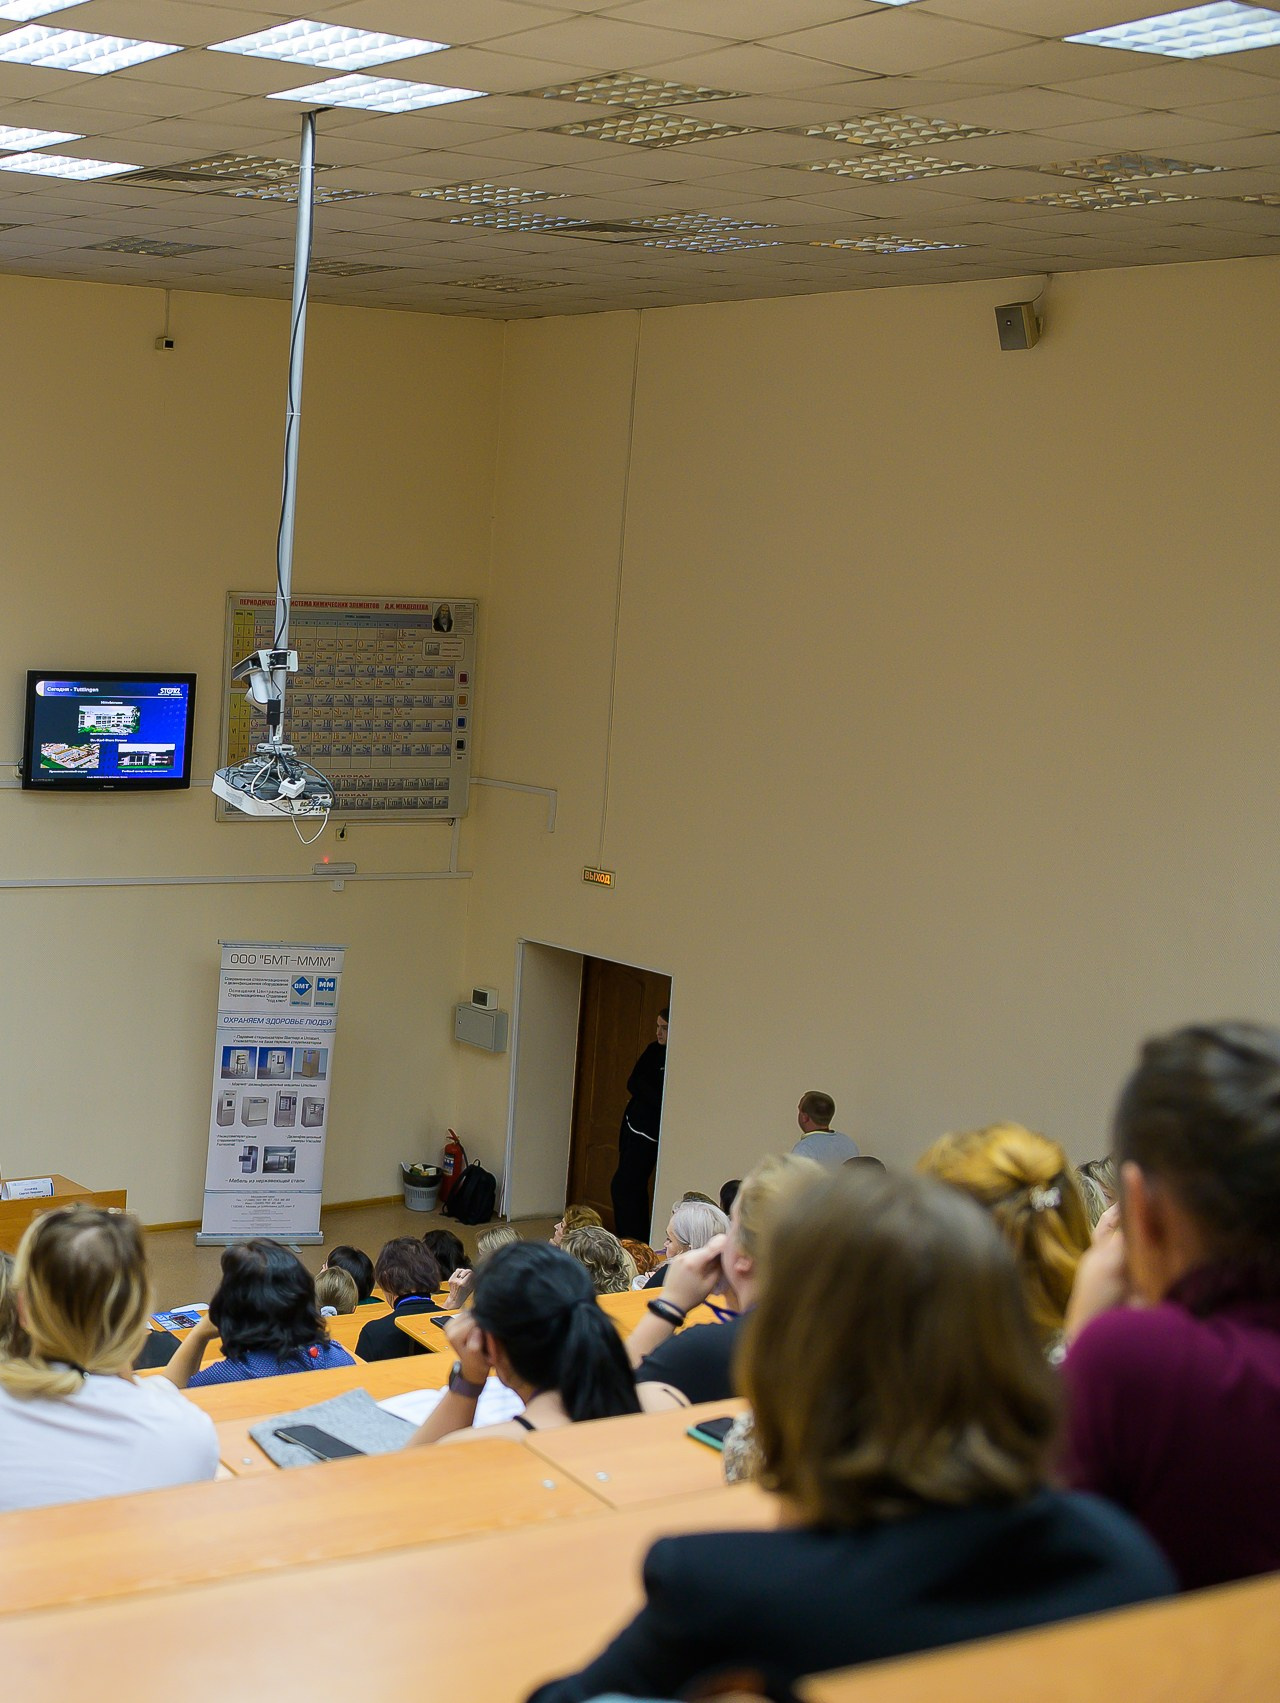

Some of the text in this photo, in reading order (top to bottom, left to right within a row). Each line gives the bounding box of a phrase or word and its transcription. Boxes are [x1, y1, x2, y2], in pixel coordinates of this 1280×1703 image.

[290, 600, 312, 608] ИСТЕМА
[584, 870, 610, 885] ВЫХОД
[230, 953, 256, 964] ООО
[223, 1016, 333, 1026] ОХРАНЯЕМ ЗДОРОВЬЕ ЛЮДЕЙ
